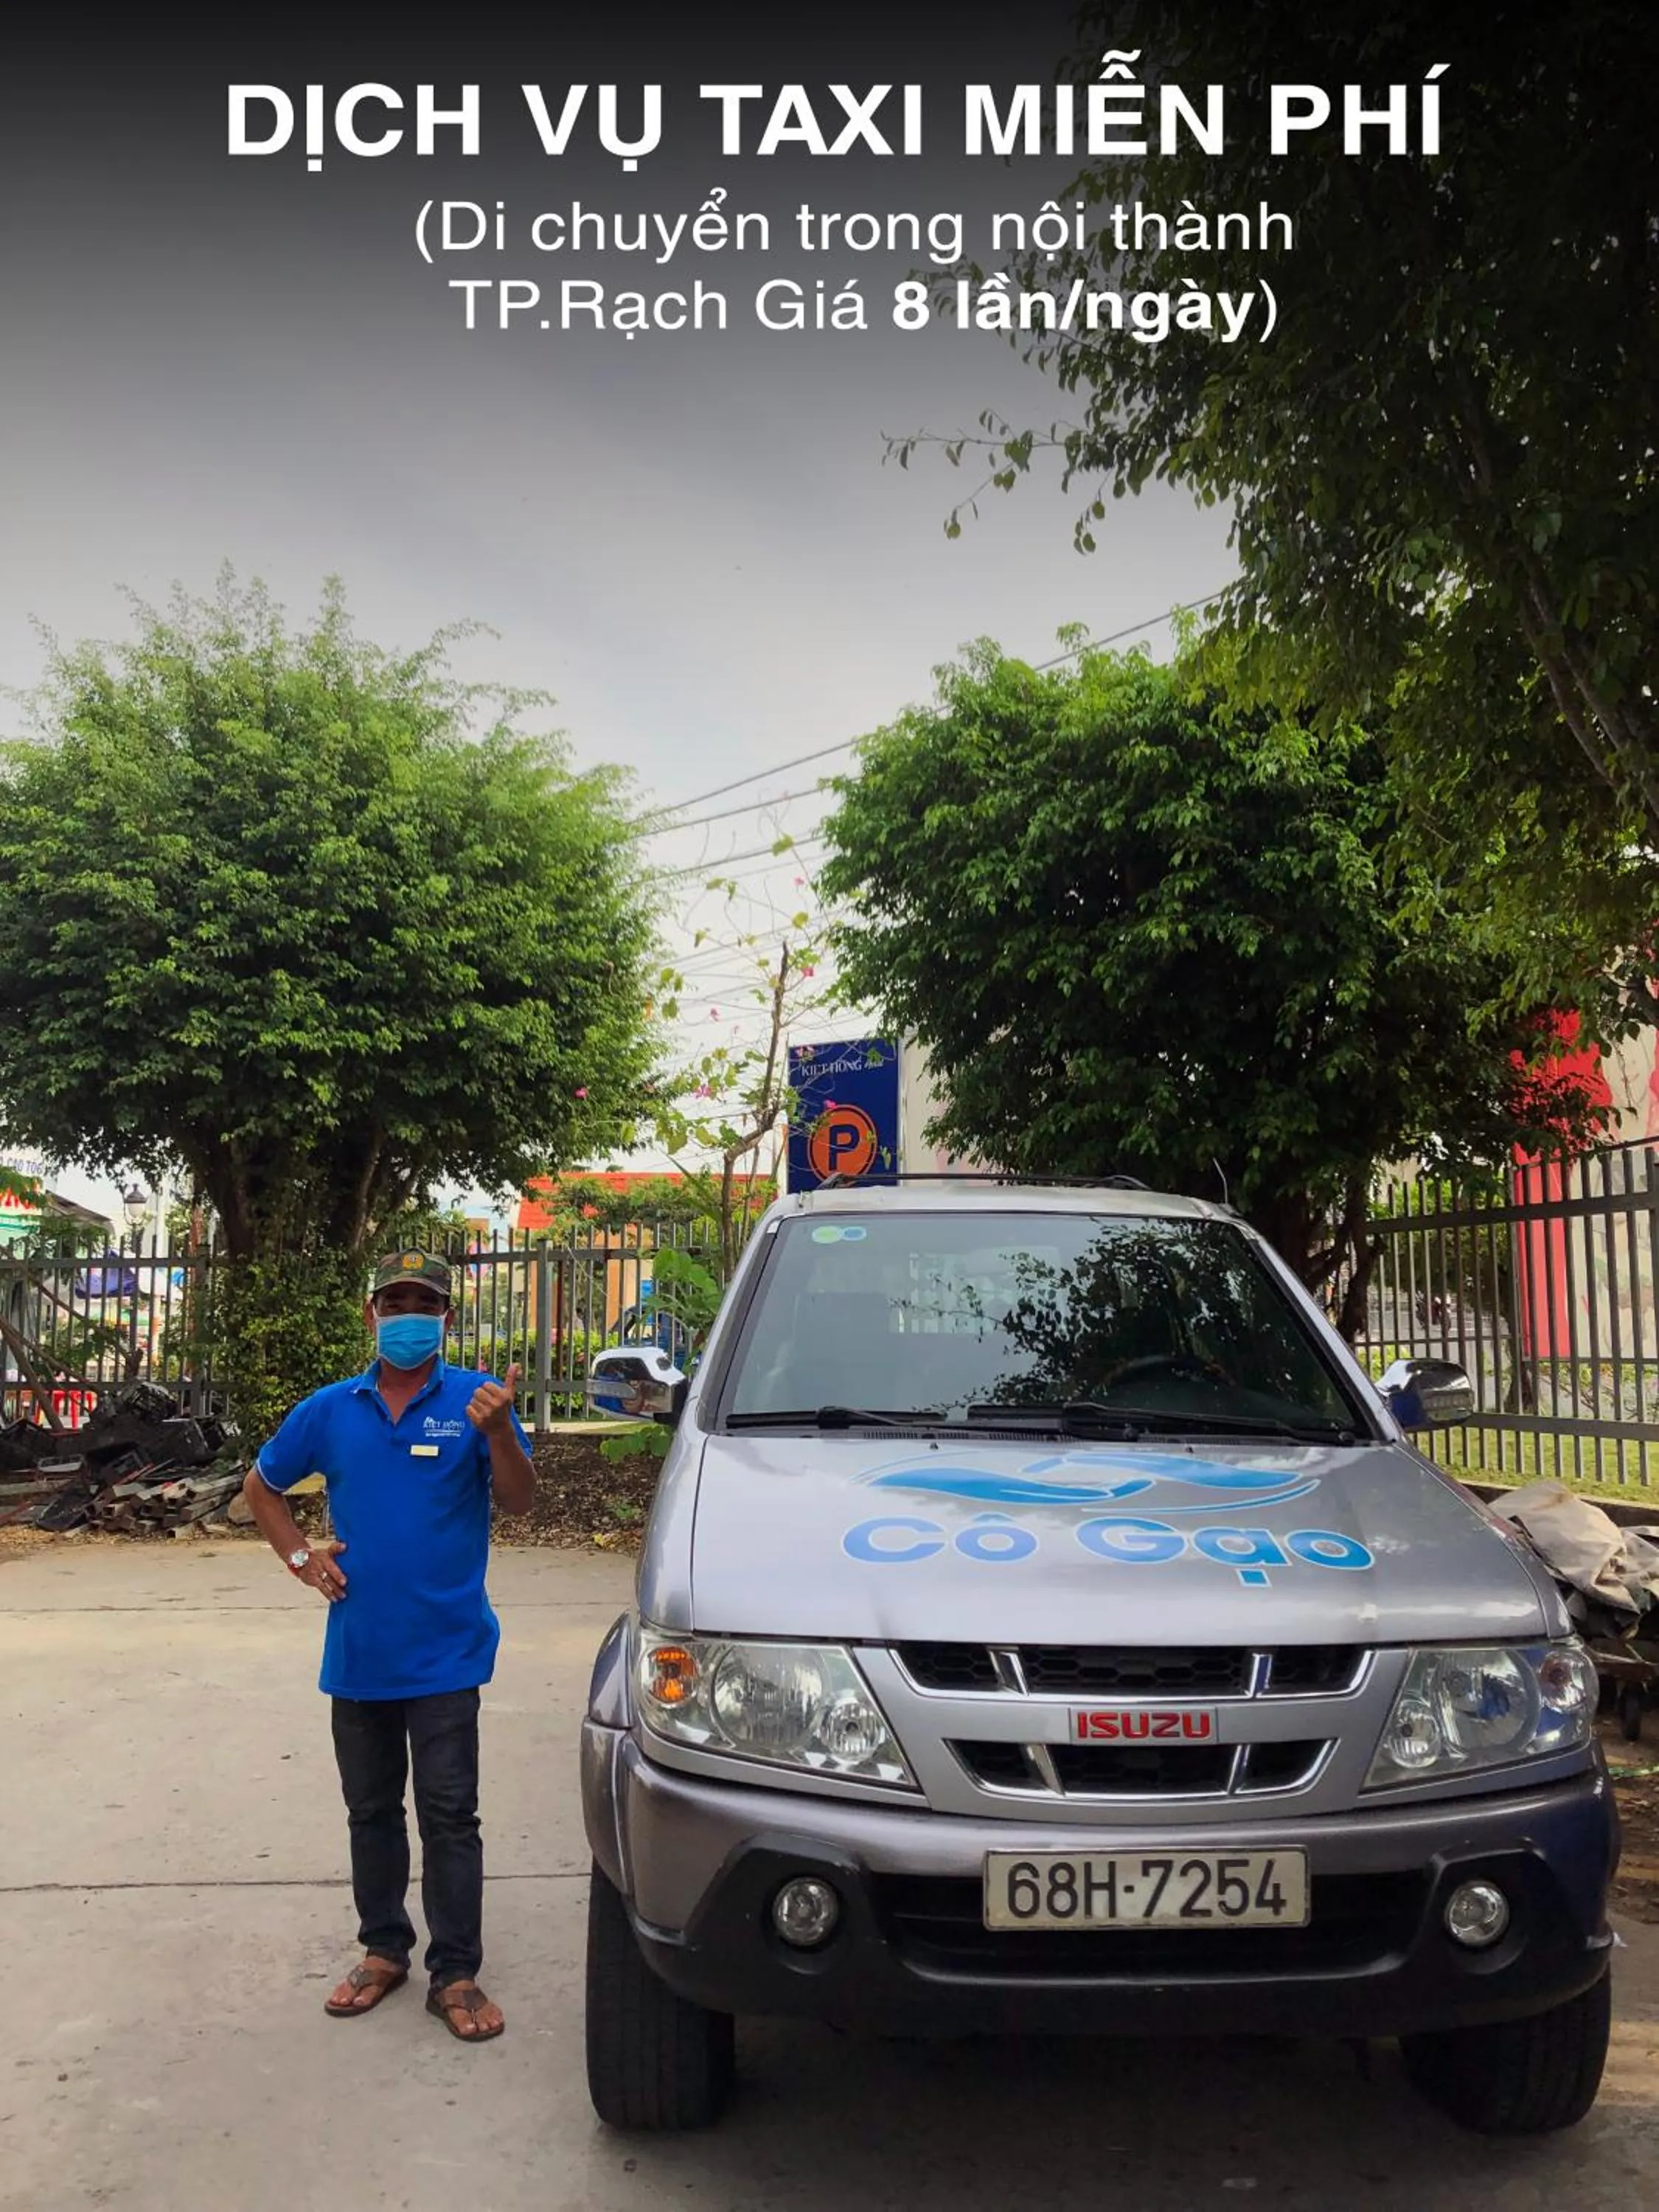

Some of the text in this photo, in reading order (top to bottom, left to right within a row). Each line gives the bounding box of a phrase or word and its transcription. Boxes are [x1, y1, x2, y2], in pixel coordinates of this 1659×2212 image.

[828, 1124, 860, 1172] P
[841, 1512, 1375, 1587] Cô Gạo
[1077, 1711, 1211, 1739] ISUZU
[1007, 1858, 1287, 1920] 68H-7254
